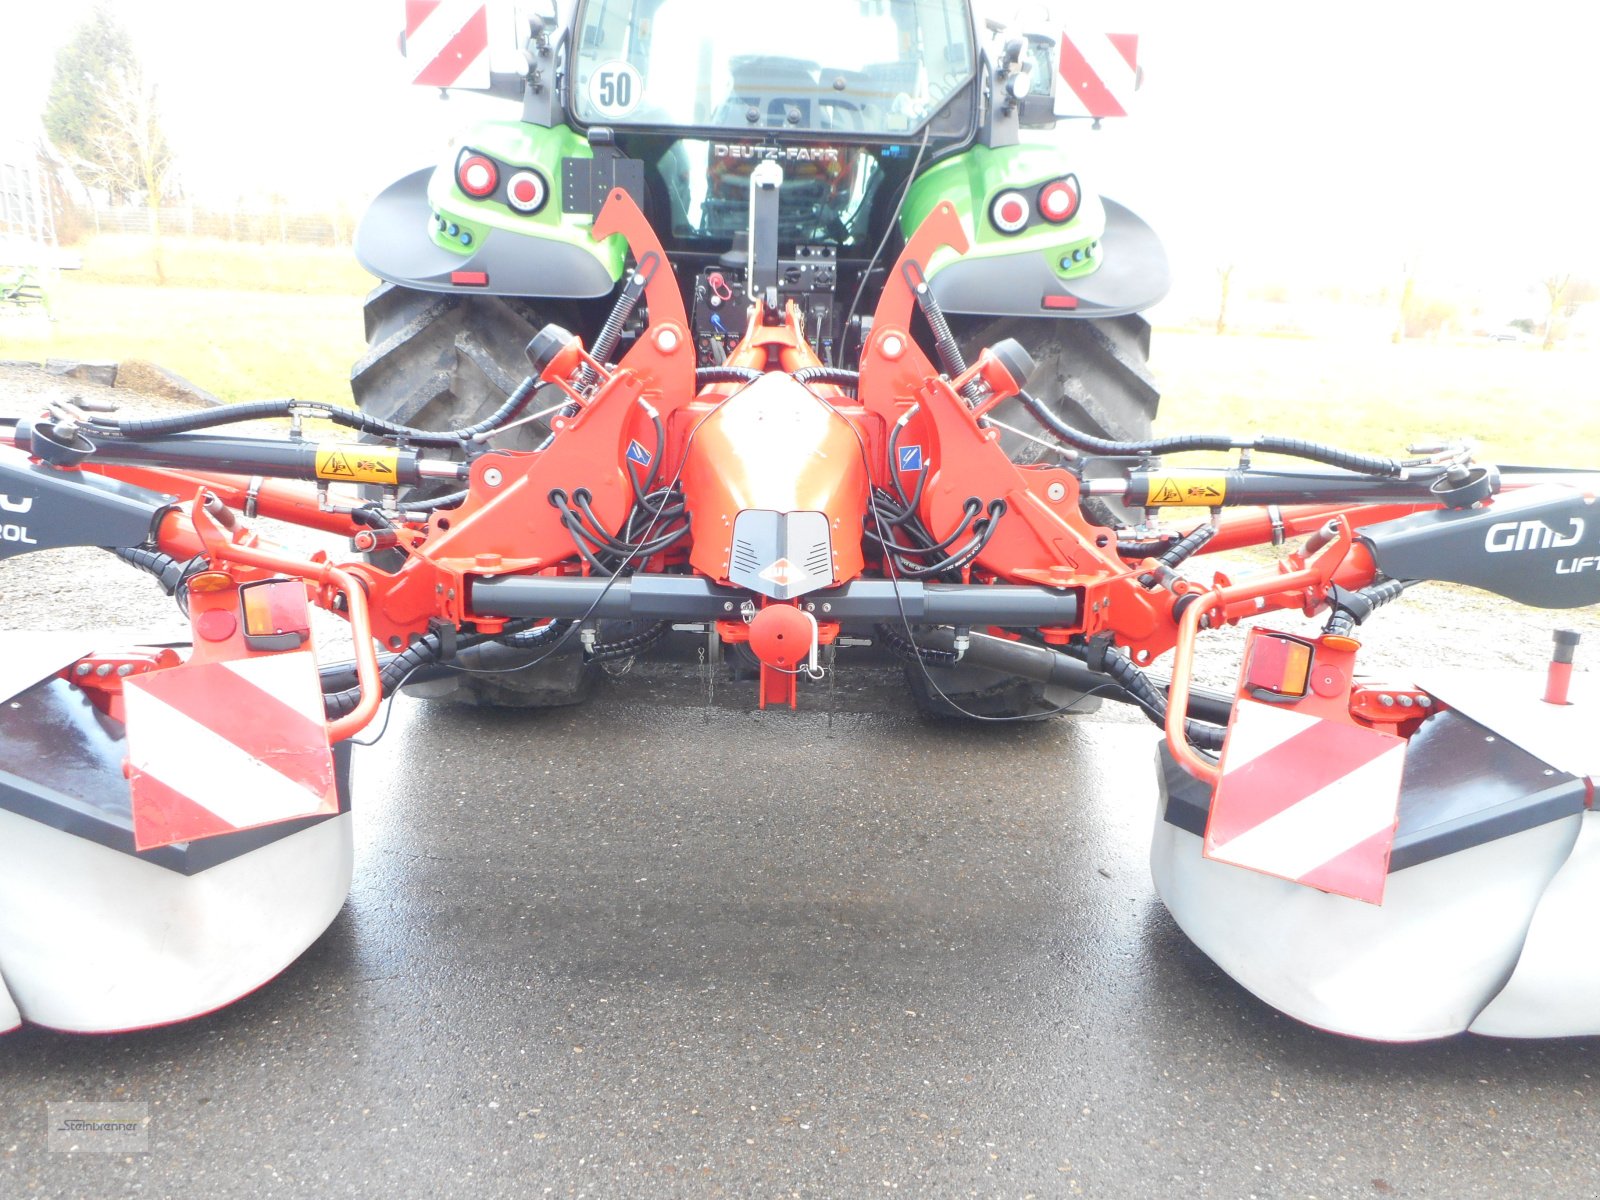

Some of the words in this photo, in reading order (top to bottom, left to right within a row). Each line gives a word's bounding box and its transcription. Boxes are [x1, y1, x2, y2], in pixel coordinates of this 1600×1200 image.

[600, 72, 631, 107] 50
[714, 144, 839, 161] DEUTZ-FAHR
[0, 525, 38, 545] OL
